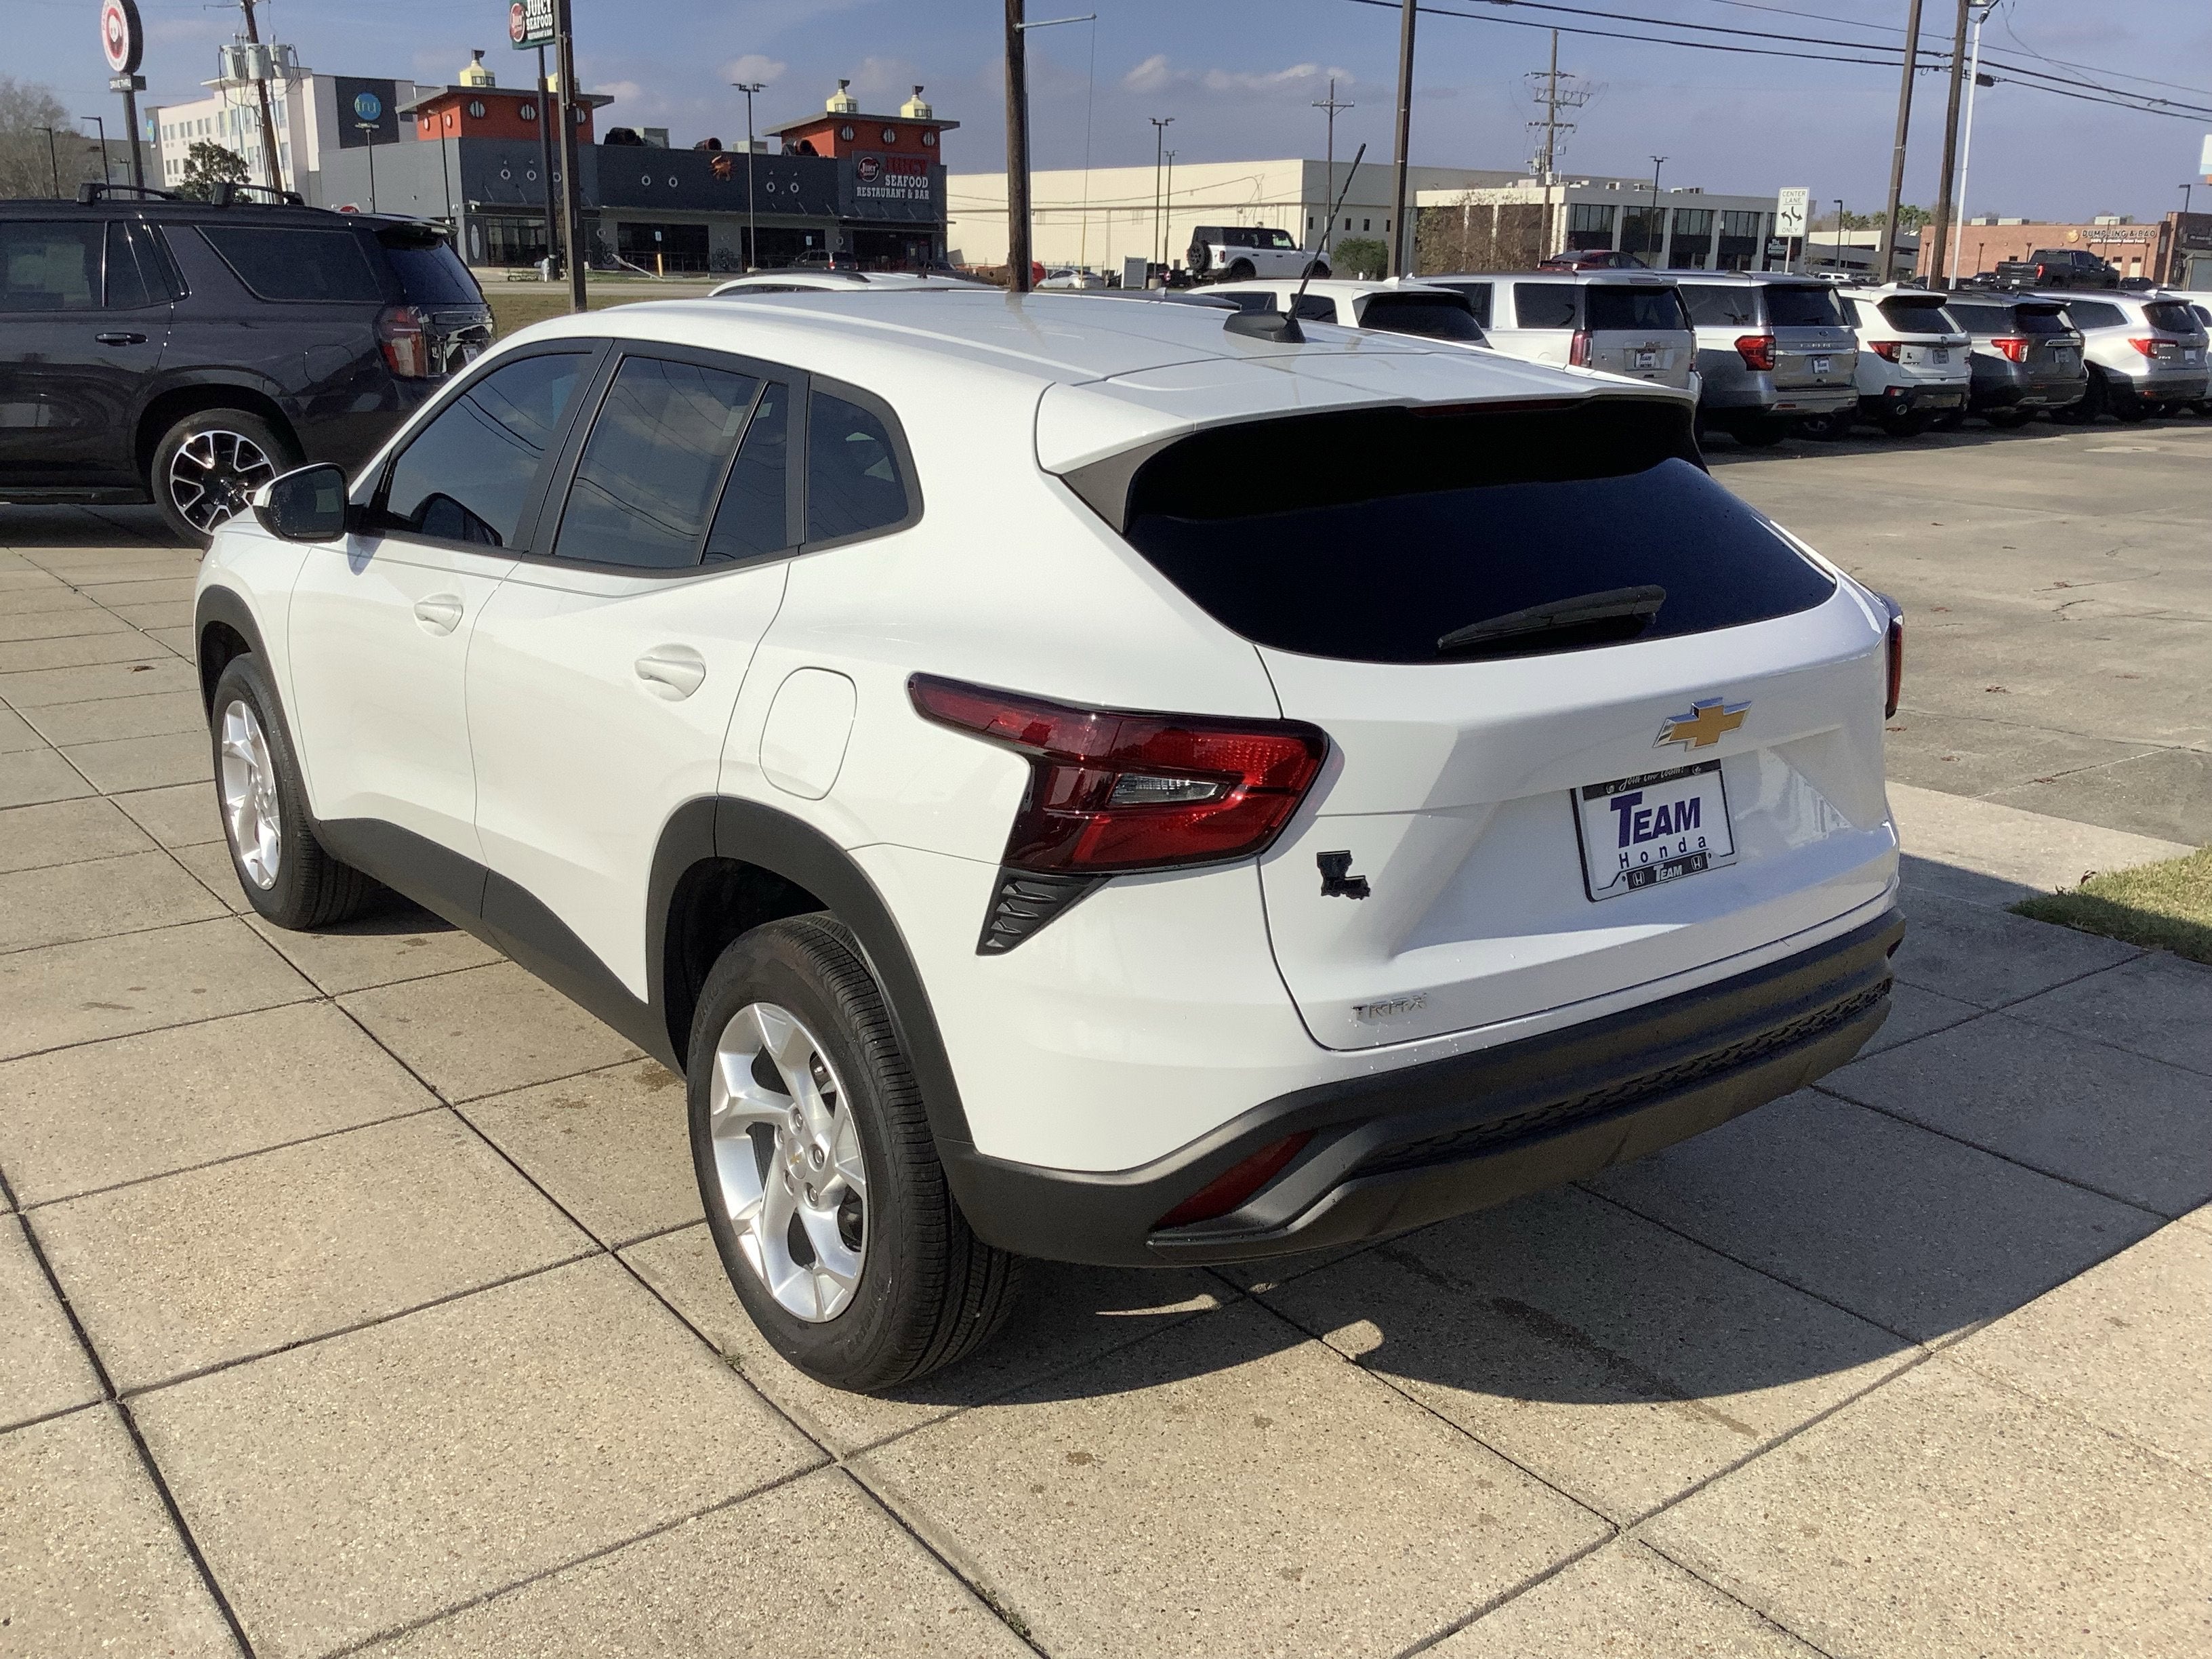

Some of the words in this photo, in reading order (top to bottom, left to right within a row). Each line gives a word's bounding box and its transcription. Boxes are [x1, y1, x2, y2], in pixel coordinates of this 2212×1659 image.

[526, 14, 553, 30] SEAFOOD
[356, 98, 376, 113] tru
[885, 174, 928, 188] SEAFOOD
[857, 186, 905, 199] RESTAURANT
[907, 189, 913, 199] &
[915, 190, 929, 199] BAR
[1610, 792, 1700, 848] TEAM
[1618, 836, 1706, 869] Honda
[1653, 864, 1683, 881] TEAM
